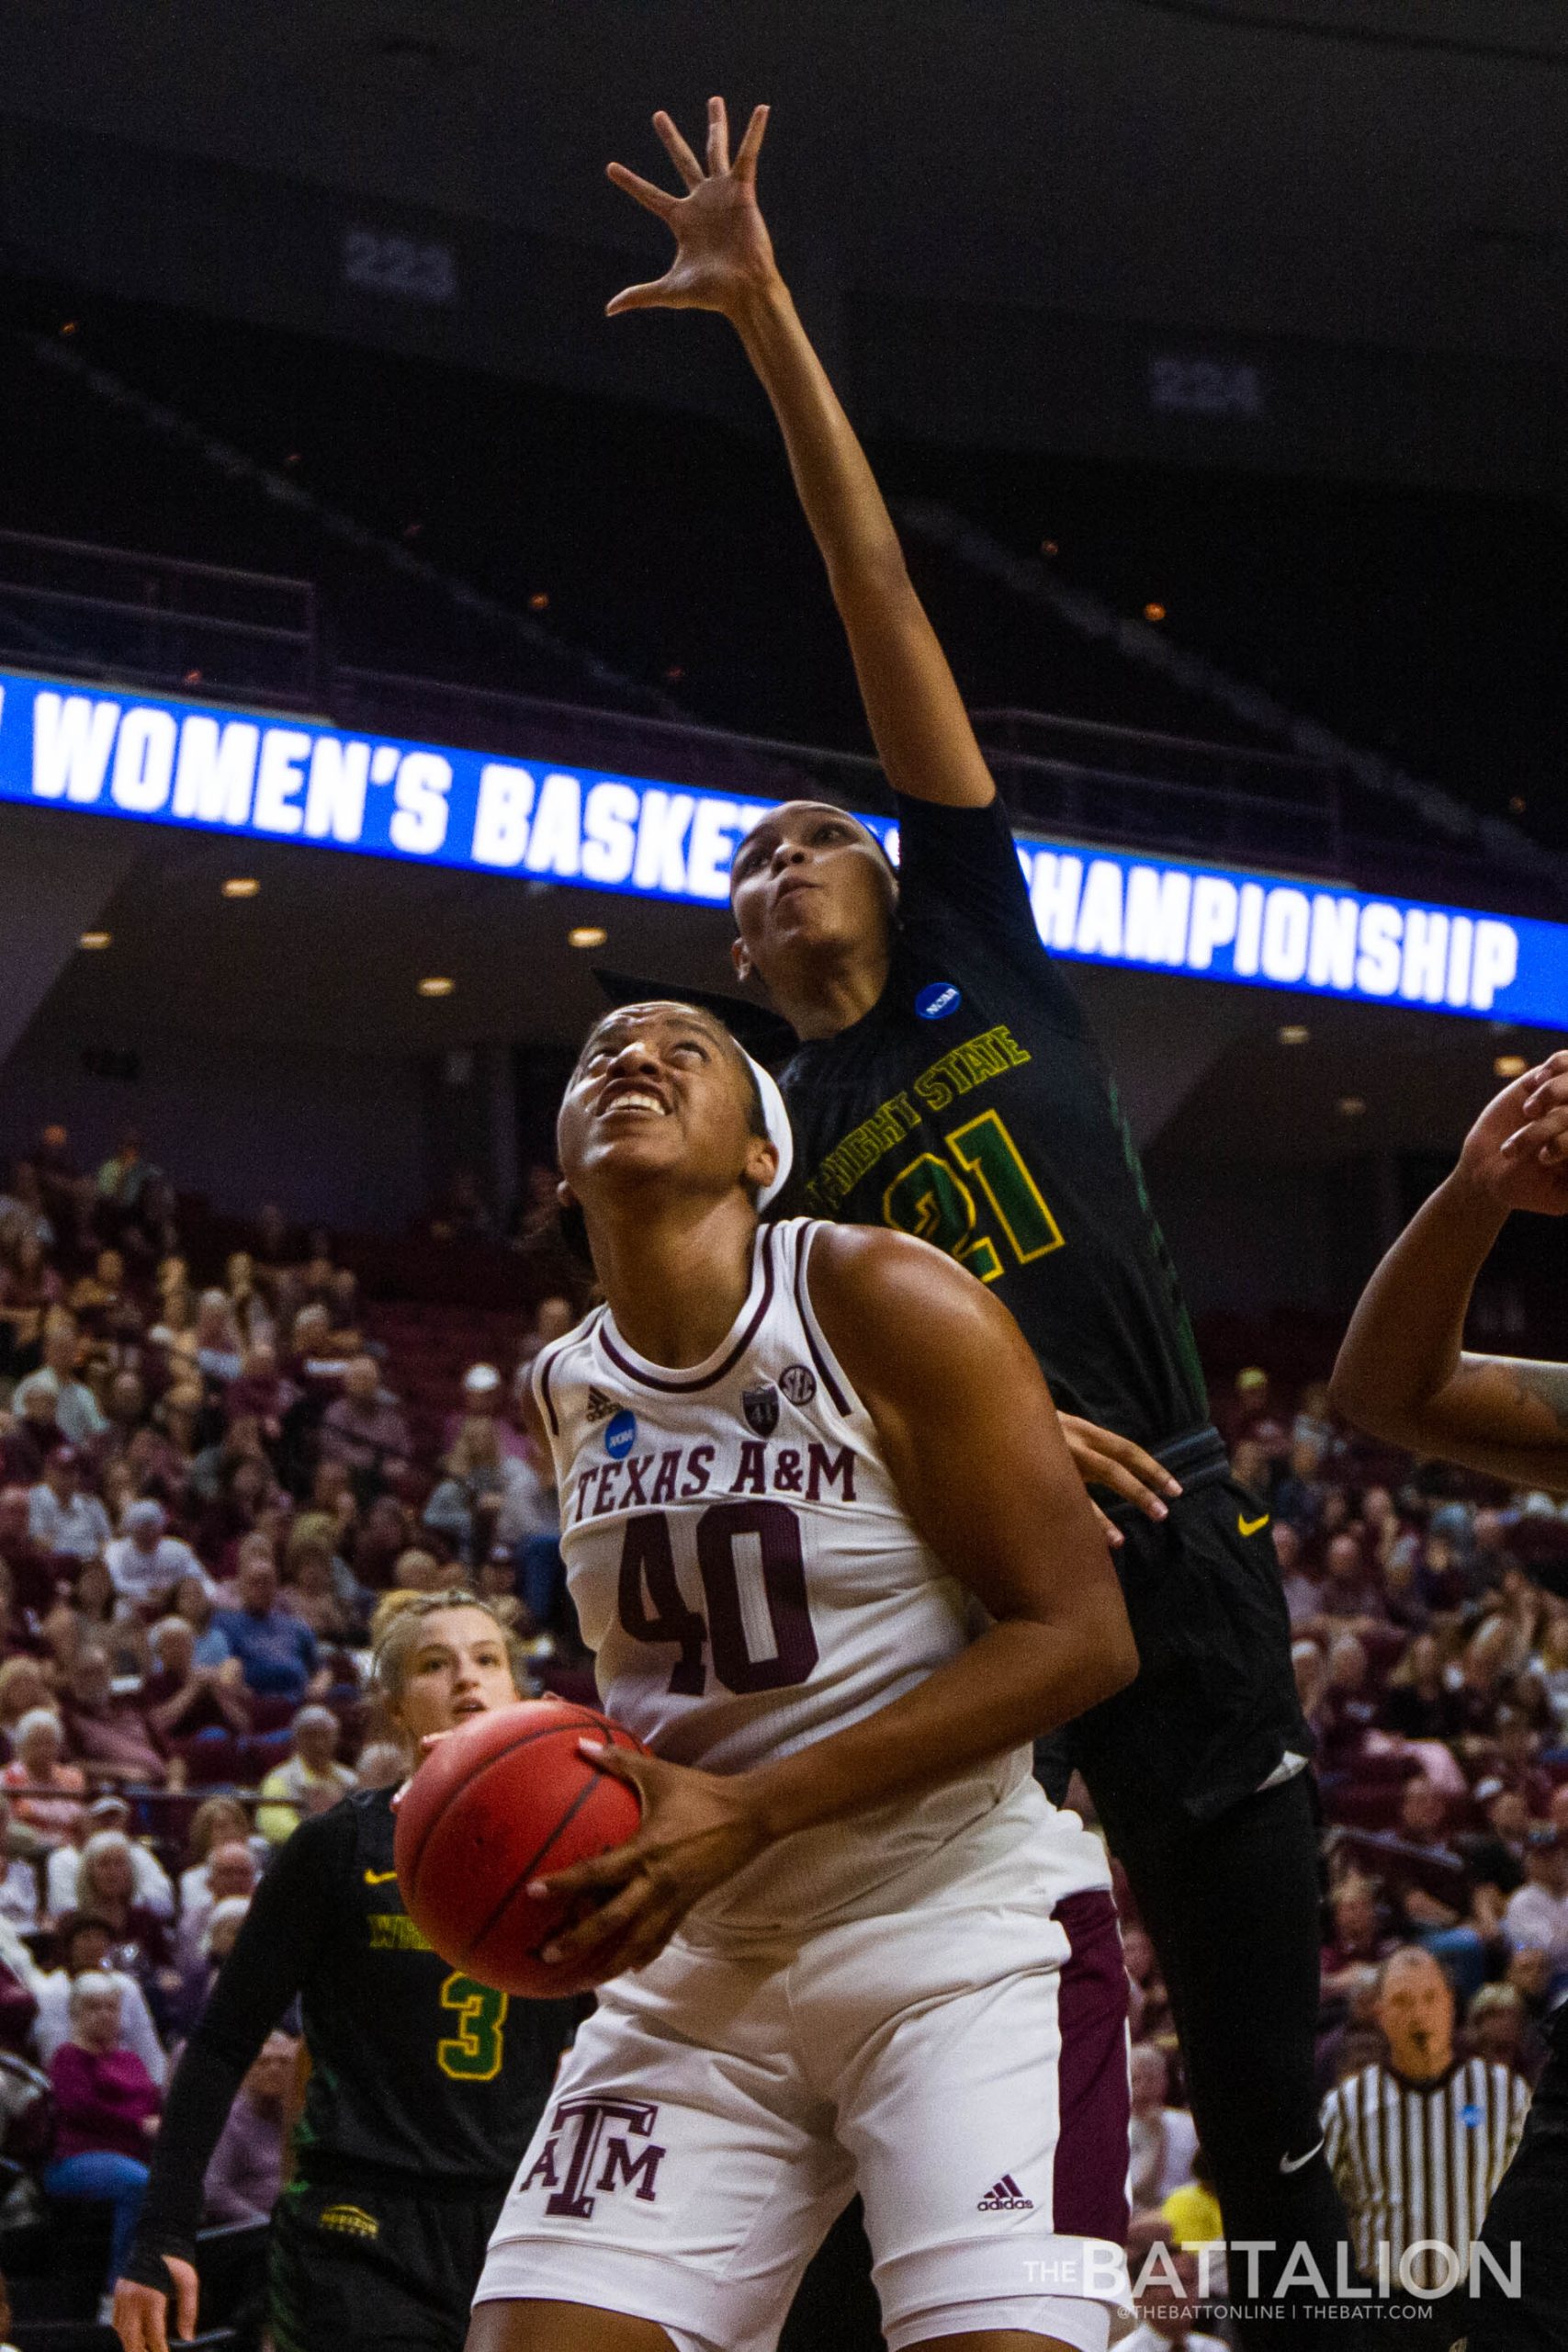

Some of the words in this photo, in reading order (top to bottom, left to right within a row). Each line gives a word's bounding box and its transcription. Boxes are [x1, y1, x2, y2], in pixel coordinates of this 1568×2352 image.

[32, 691, 451, 856] WOMEN'S
[1016, 847, 1519, 1011] HAMPIONSHIP
[914, 1024, 1032, 1112] STATE
[883, 1108, 1066, 1283] 21
[575, 1445, 716, 1522] TEXAS
[728, 1441, 859, 1502] A&M
[617, 1499, 820, 1696] 40
[436, 1971, 510, 2081] 3
[976, 2197, 1034, 2211] adidas
